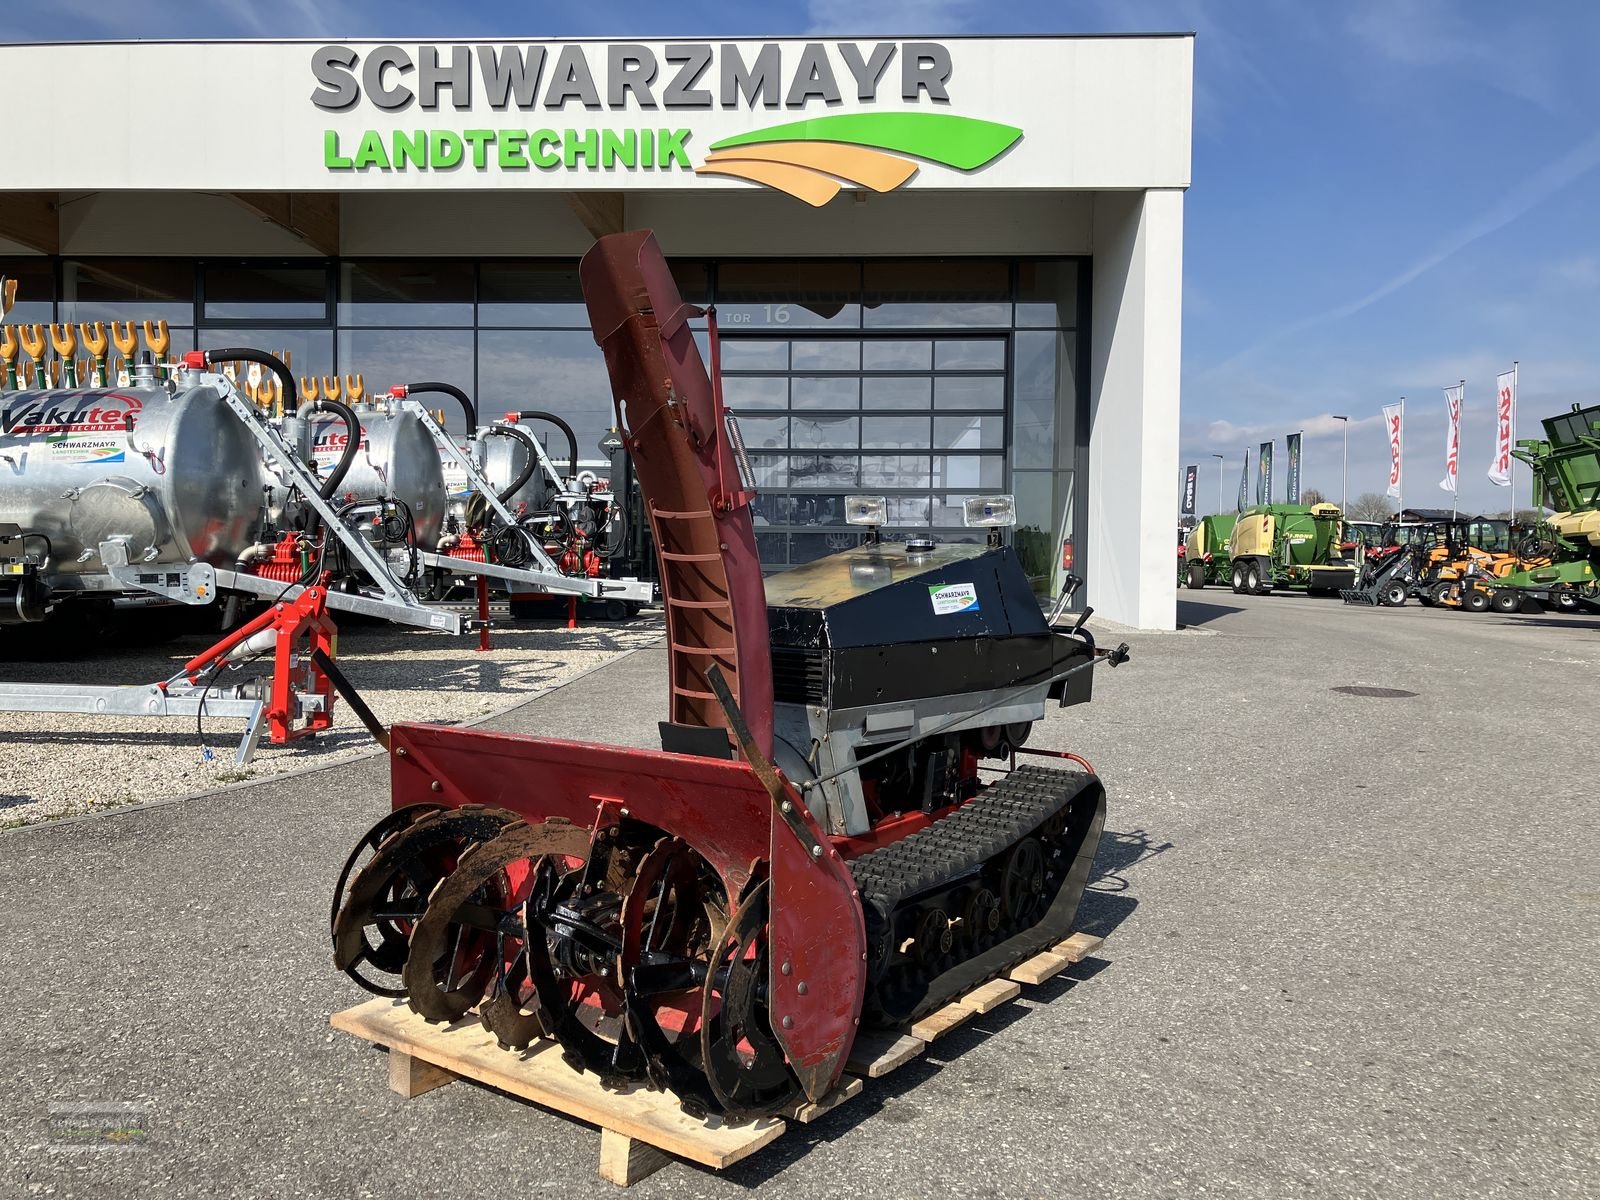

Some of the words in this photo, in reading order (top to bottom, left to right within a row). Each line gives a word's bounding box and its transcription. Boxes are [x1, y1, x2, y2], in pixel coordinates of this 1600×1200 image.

[310, 41, 951, 111] SCHWARZMAYR
[324, 128, 693, 172] LANDTECHNIK
[725, 313, 751, 323] TOR
[764, 303, 790, 323] 16
[2, 403, 142, 434] Vakutec
